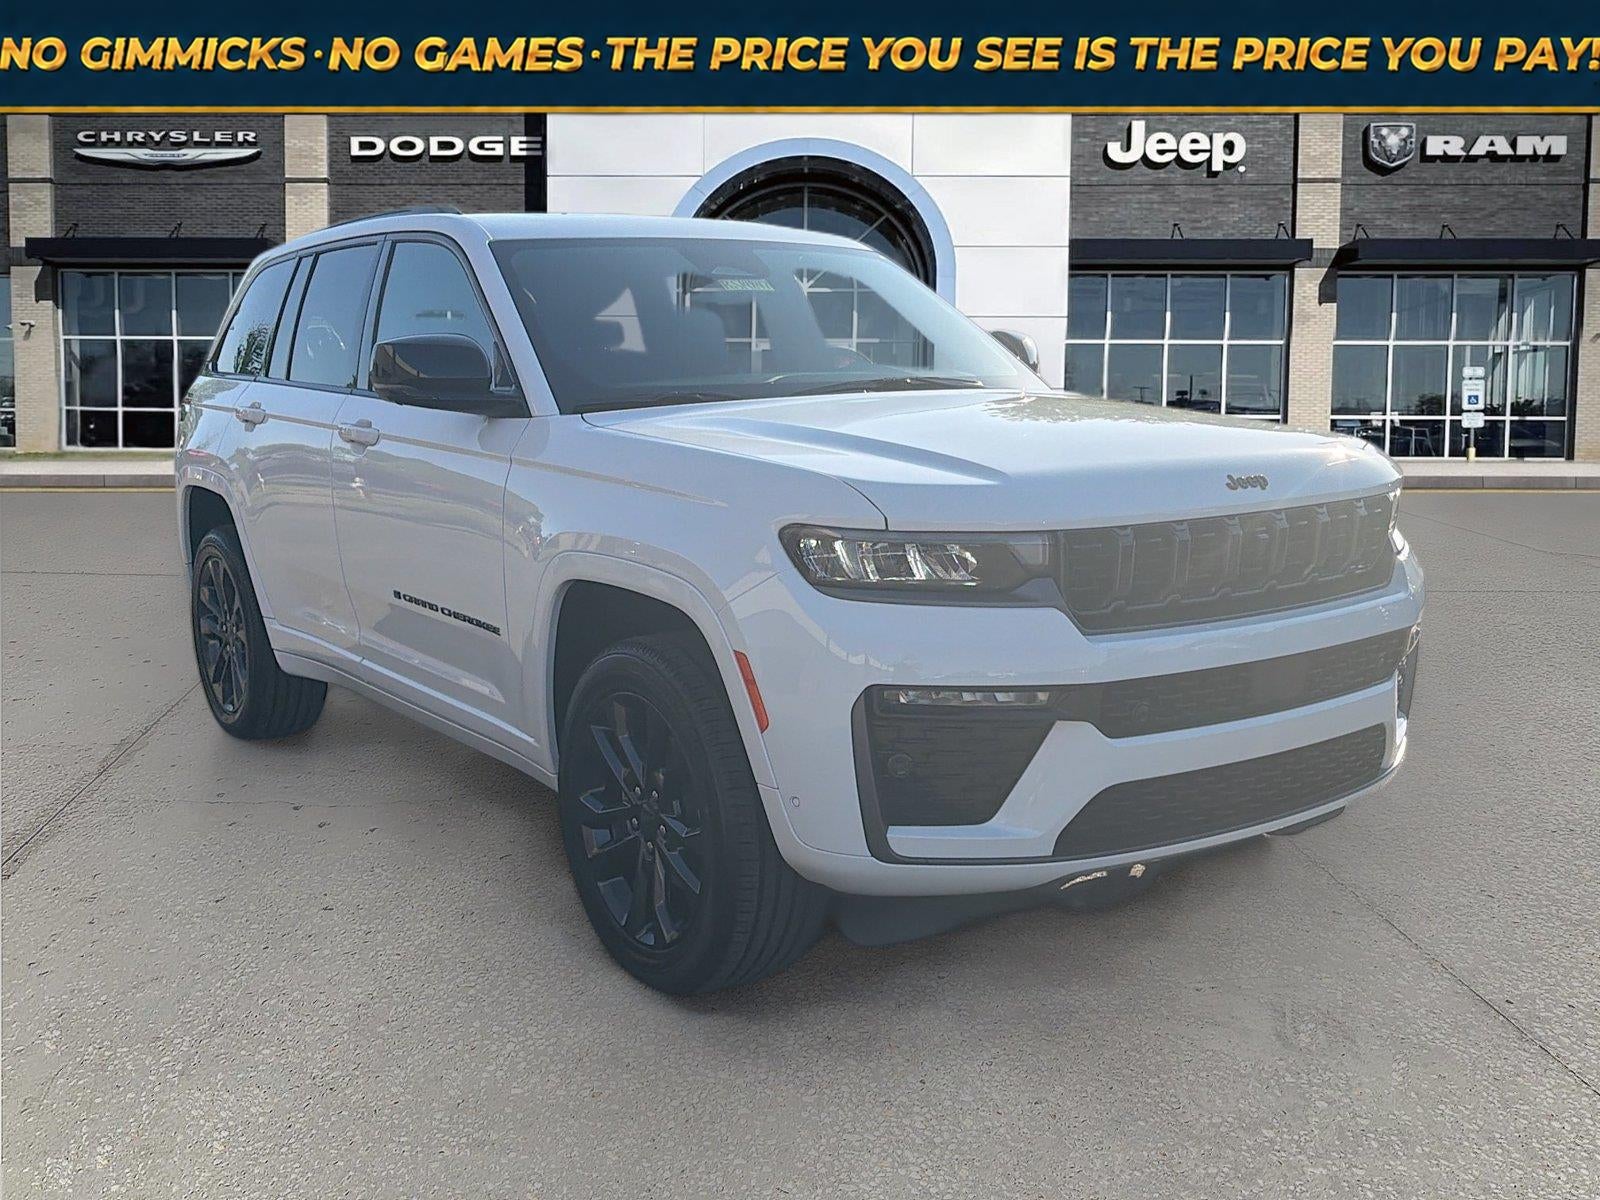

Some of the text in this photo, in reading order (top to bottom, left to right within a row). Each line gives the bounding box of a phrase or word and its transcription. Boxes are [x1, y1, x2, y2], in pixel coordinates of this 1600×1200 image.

[76, 130, 257, 143] CHRYSLER
[349, 135, 543, 156] DODGE
[1107, 120, 1247, 172] Jeep
[1425, 135, 1568, 156] RAM
[1226, 474, 1269, 490] Jeep
[402, 593, 439, 613] GRAND
